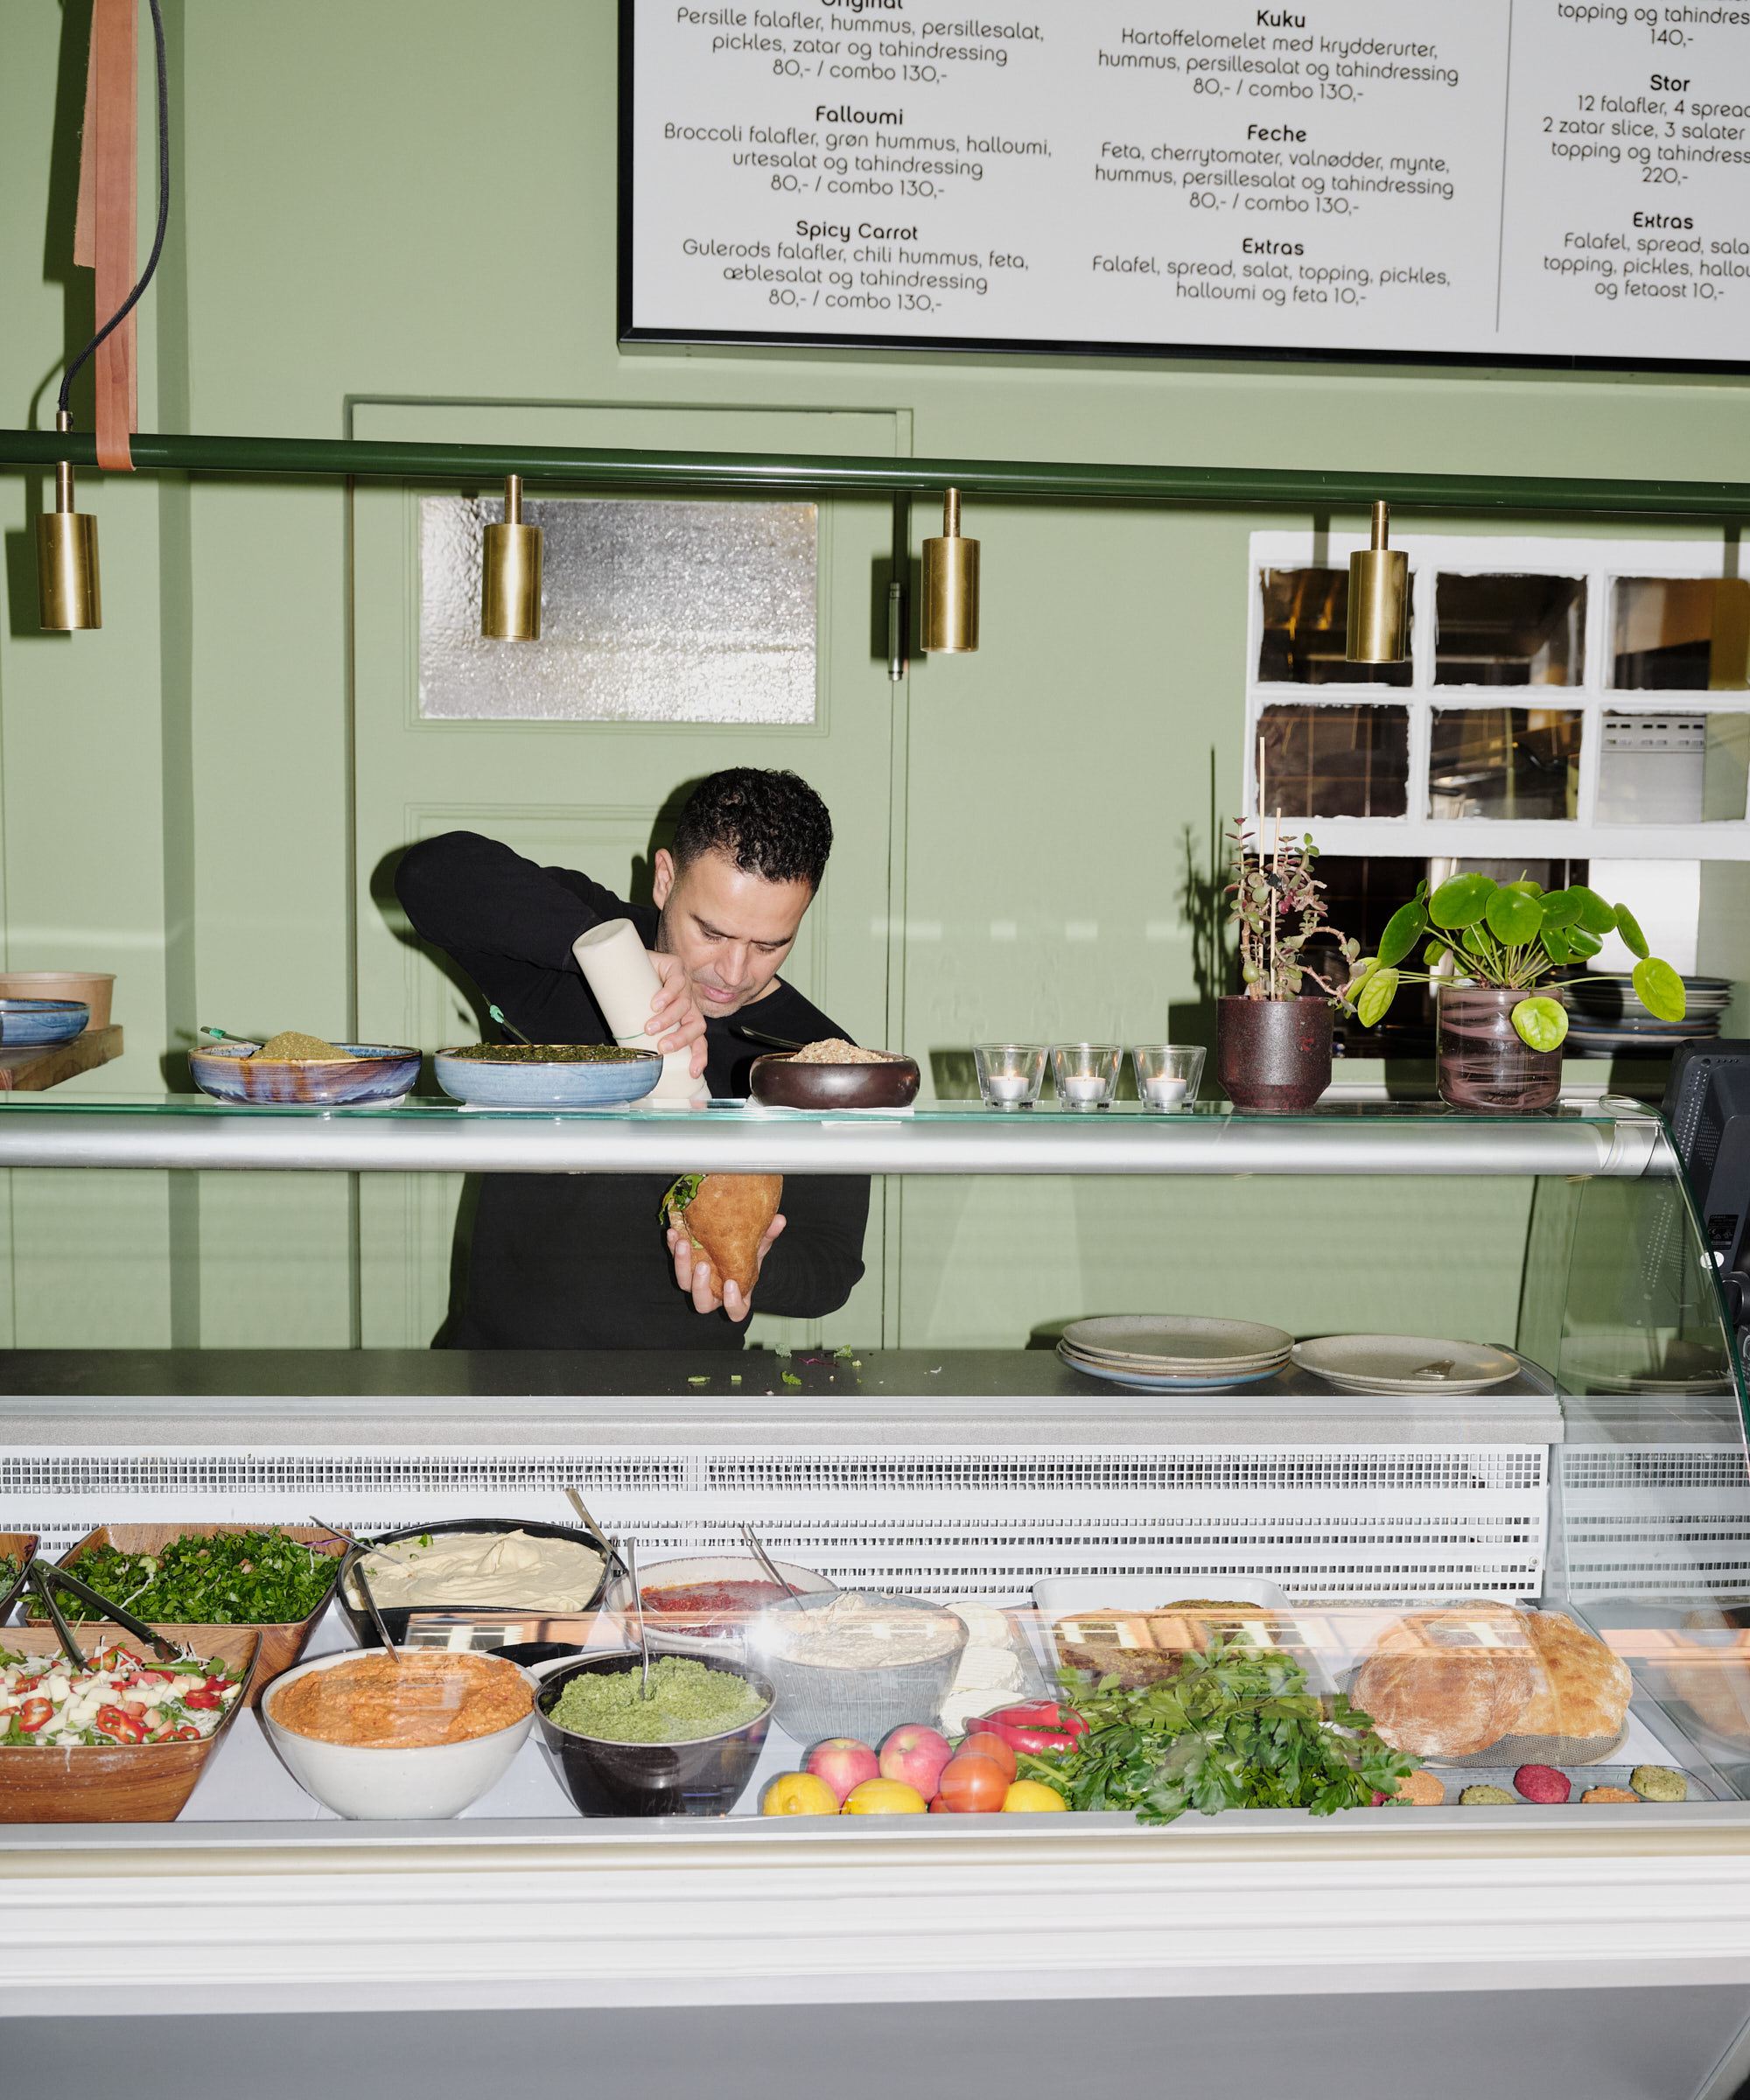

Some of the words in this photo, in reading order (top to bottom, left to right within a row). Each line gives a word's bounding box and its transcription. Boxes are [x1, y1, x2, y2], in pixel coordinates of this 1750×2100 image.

[676, 6, 747, 27] Persille
[753, 9, 824, 32] falafler,
[830, 13, 915, 36] hummus,
[921, 19, 1044, 43] persillesalat,
[1256, 9, 1306, 29] Kuku
[1558, 2, 1628, 26] topping
[1634, 8, 1658, 27] og
[1664, 4, 1750, 25] tahindres
[711, 32, 787, 54] pickles,
[792, 38, 842, 55] zatar
[847, 41, 872, 61] og
[878, 39, 1008, 67] tahindressing
[1272, 35, 1314, 52] med
[1320, 35, 1438, 60] krydderurter,
[1650, 27, 1694, 48] 140,-
[772, 58, 811, 79] 80,-
[816, 60, 824, 78] /
[829, 62, 897, 81] combo
[902, 64, 948, 85] 130,-
[1098, 48, 1180, 72] hummus,
[1186, 54, 1300, 75] persillesalat
[1305, 62, 1330, 82] og
[1335, 60, 1460, 88] tahindressing
[1193, 77, 1231, 97] 80,-
[1236, 78, 1243, 96] /
[1248, 80, 1314, 100] combo
[1320, 82, 1364, 103] 130,-
[1649, 74, 1691, 93] Stor
[815, 104, 904, 126] Falloumi
[1578, 94, 1595, 112] 12
[1600, 94, 1668, 117] falafler,
[1673, 99, 1685, 116] 4
[664, 122, 742, 143] Broccoli
[749, 125, 819, 148] falafler,
[825, 133, 869, 152] grøn
[875, 130, 960, 154] hummus,
[966, 134, 1052, 158] halloumi,
[1247, 123, 1308, 144] Feche
[1543, 116, 1554, 133] 2
[1558, 119, 1606, 135] zatar
[1611, 118, 1658, 139] slice,
[1663, 121, 1676, 138] 3
[1681, 122, 1746, 141] salater
[1101, 141, 1145, 162] Feta,
[1151, 143, 1283, 168] cherrytomater,
[1288, 149, 1384, 172] valnødder,
[1390, 157, 1450, 176] mynte,
[1551, 141, 1621, 164] topping
[1627, 146, 1651, 165] og
[732, 150, 817, 169] urtesalat
[822, 157, 848, 176] og
[855, 154, 984, 182] tahindressing
[1642, 165, 1689, 186] 220,-
[770, 173, 809, 194] 80,-
[815, 175, 822, 192] /
[827, 177, 894, 196] combo
[900, 179, 945, 200] 130,-
[1095, 163, 1177, 186] hummus,
[1182, 169, 1296, 190] persillesalat
[1301, 176, 1326, 196] og
[1331, 174, 1454, 201] tahindressing
[1189, 191, 1227, 211] 80,-
[1232, 192, 1240, 210] /
[1244, 194, 1310, 214] combo
[1315, 196, 1360, 216] 130,-
[795, 219, 851, 244] Spicy
[858, 221, 919, 242] Carrot
[1632, 210, 1695, 231] Extras
[682, 238, 771, 259] Gulerods
[777, 241, 847, 263] falafler,
[852, 245, 892, 263] chili
[899, 246, 983, 270] hummus,
[989, 249, 1029, 271] feta,
[1241, 236, 1305, 256] Extras
[1564, 231, 1631, 252] Falafel,
[1636, 235, 1704, 256] spread,
[1710, 237, 1750, 256] sala
[723, 263, 822, 284] æblesalat
[829, 271, 853, 290] og
[860, 269, 988, 296] tahindressing
[1092, 255, 1161, 276] Falafel,
[1166, 259, 1236, 280] spread,
[1242, 261, 1292, 281] salat,
[1298, 264, 1374, 287] topping,
[1379, 266, 1451, 287] pickles,
[1544, 256, 1617, 278] topping,
[1622, 257, 1693, 277] pickles,
[768, 288, 807, 308] 80,-
[812, 289, 820, 307] /
[824, 291, 892, 310] combo
[897, 293, 942, 313] 130,-
[1176, 280, 1256, 300] halloumi
[1262, 288, 1286, 307] og
[1292, 284, 1328, 304] feta
[1334, 287, 1367, 306] 10,-
[1594, 282, 1619, 301] og
[1624, 279, 1687, 298] fetaost
[1693, 282, 1725, 301] 10,-
